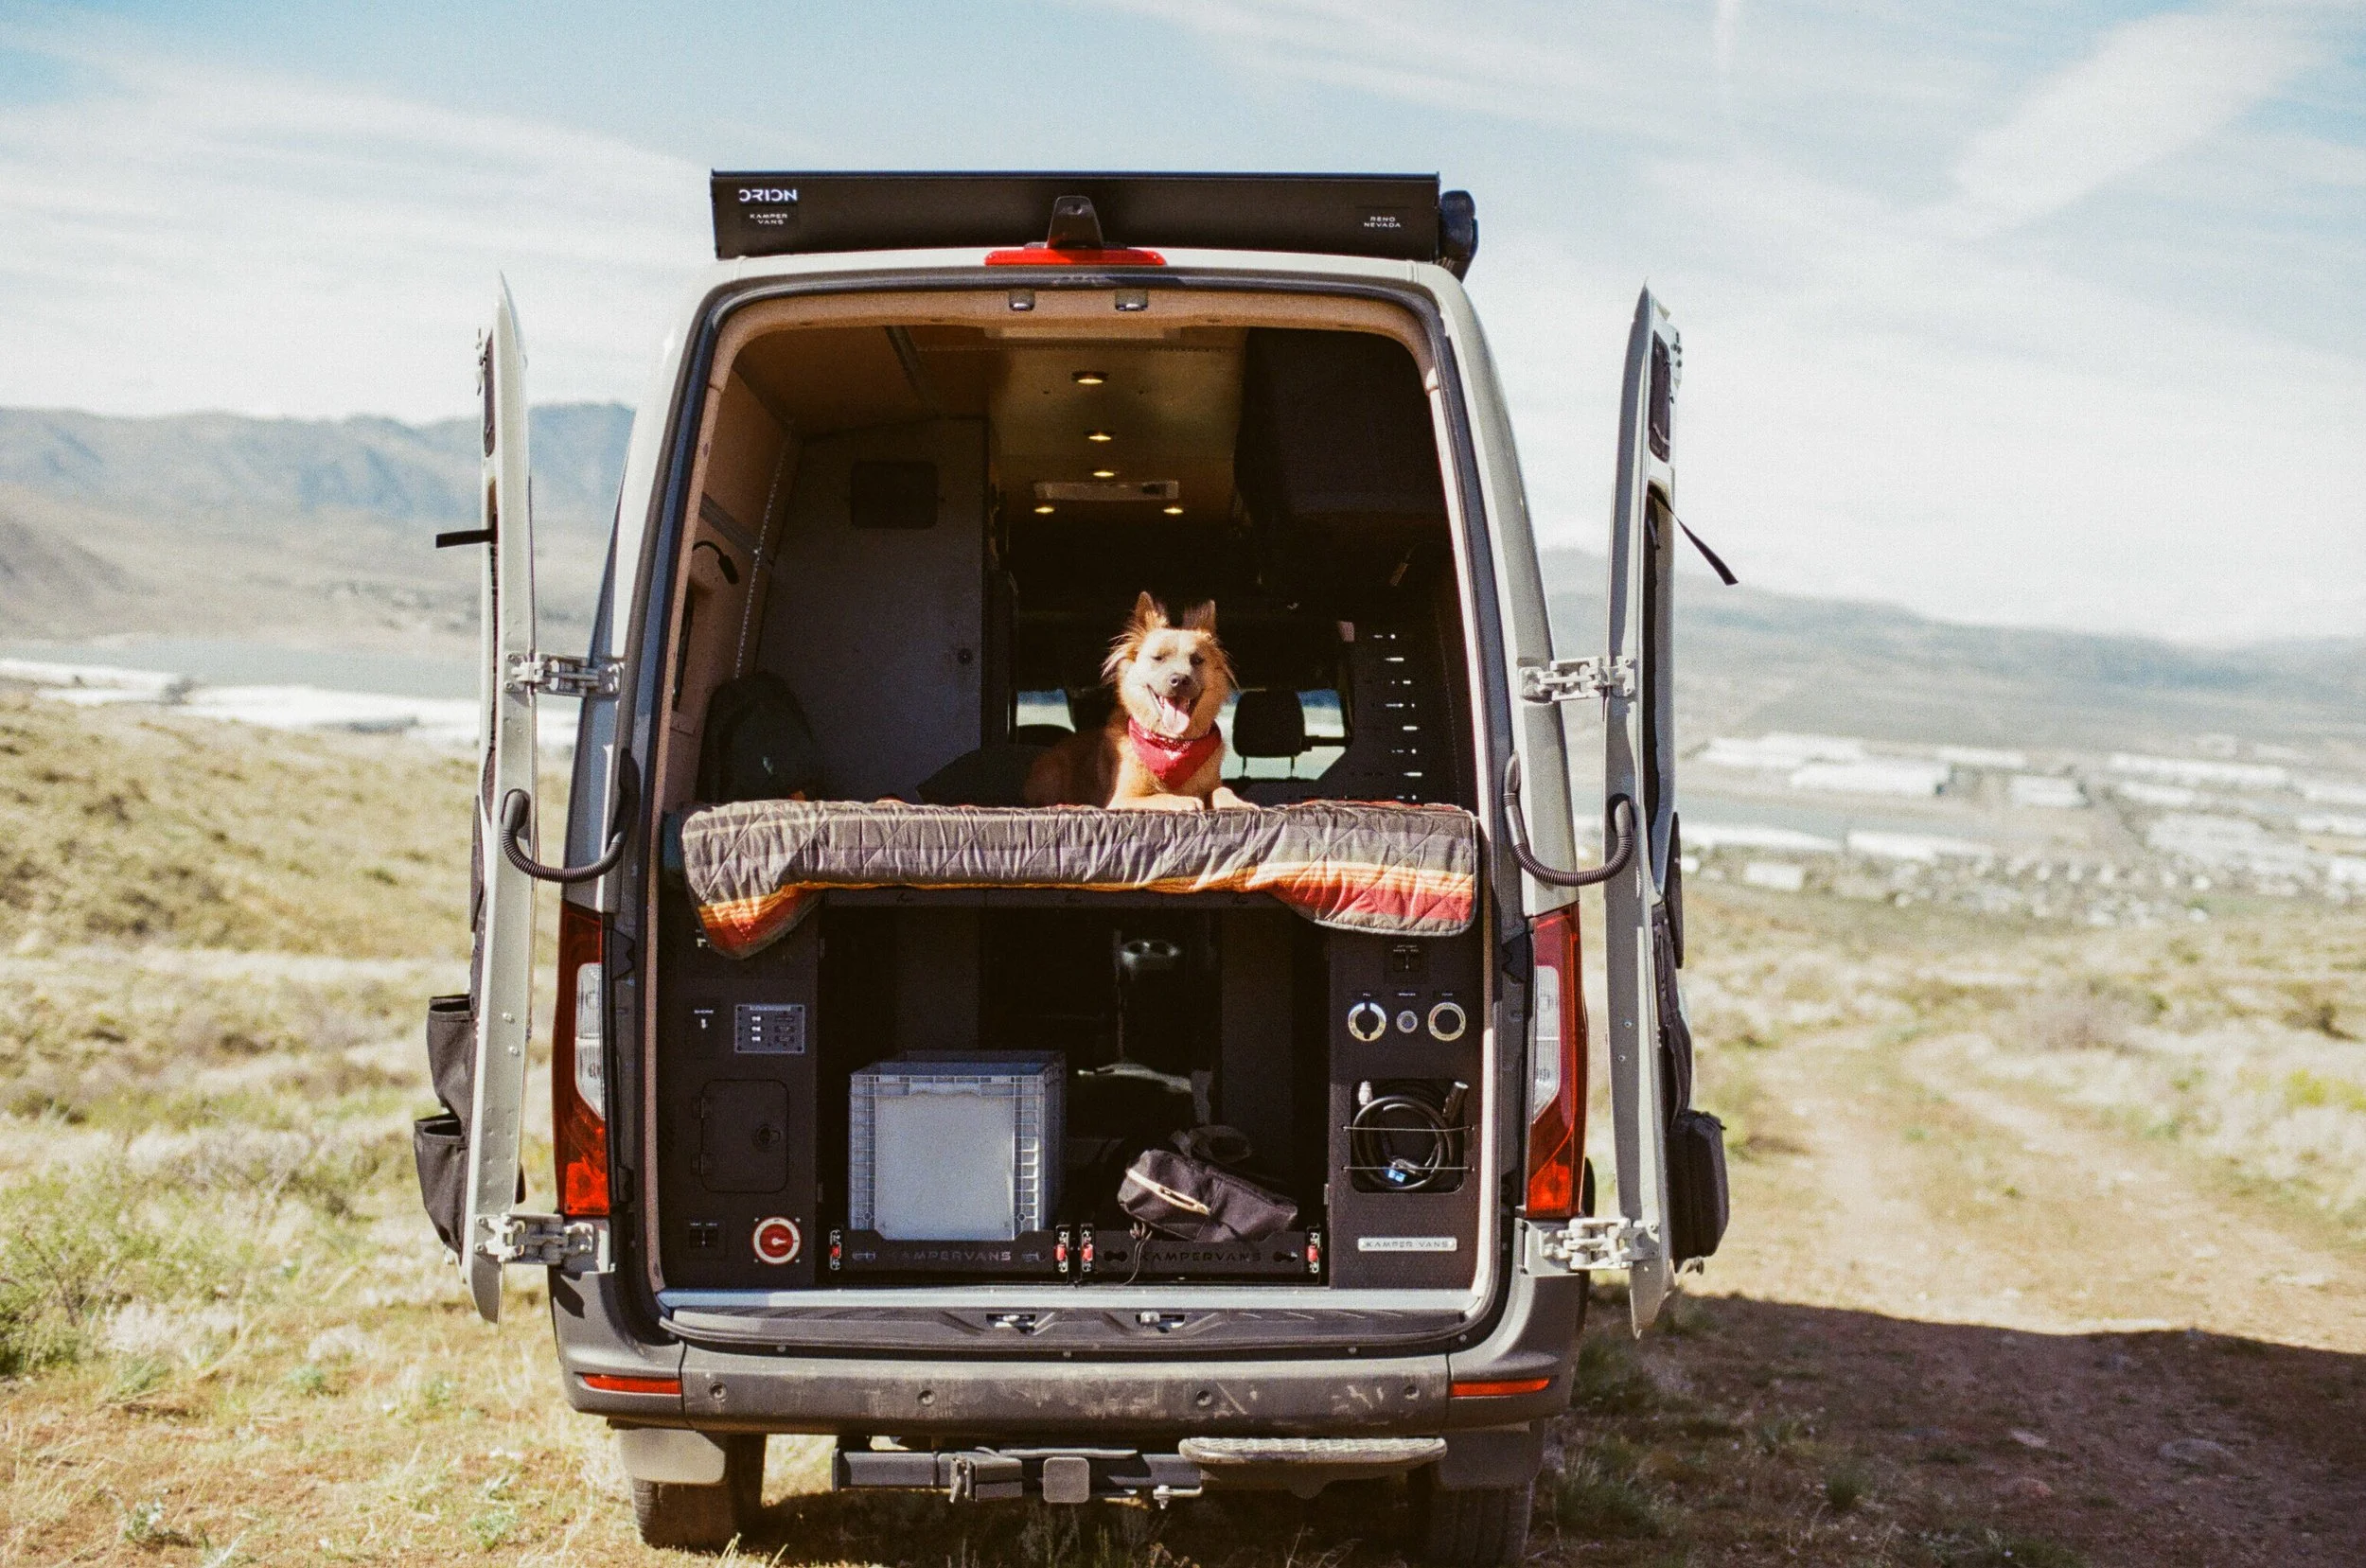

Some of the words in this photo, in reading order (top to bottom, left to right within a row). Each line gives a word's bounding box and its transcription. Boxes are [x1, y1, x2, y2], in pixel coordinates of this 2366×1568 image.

[738, 188, 798, 202] ORION
[1365, 1241, 1413, 1249] KAMPER
[1418, 1241, 1448, 1249] VANS
[887, 1250, 1012, 1261] AMPERVANS
